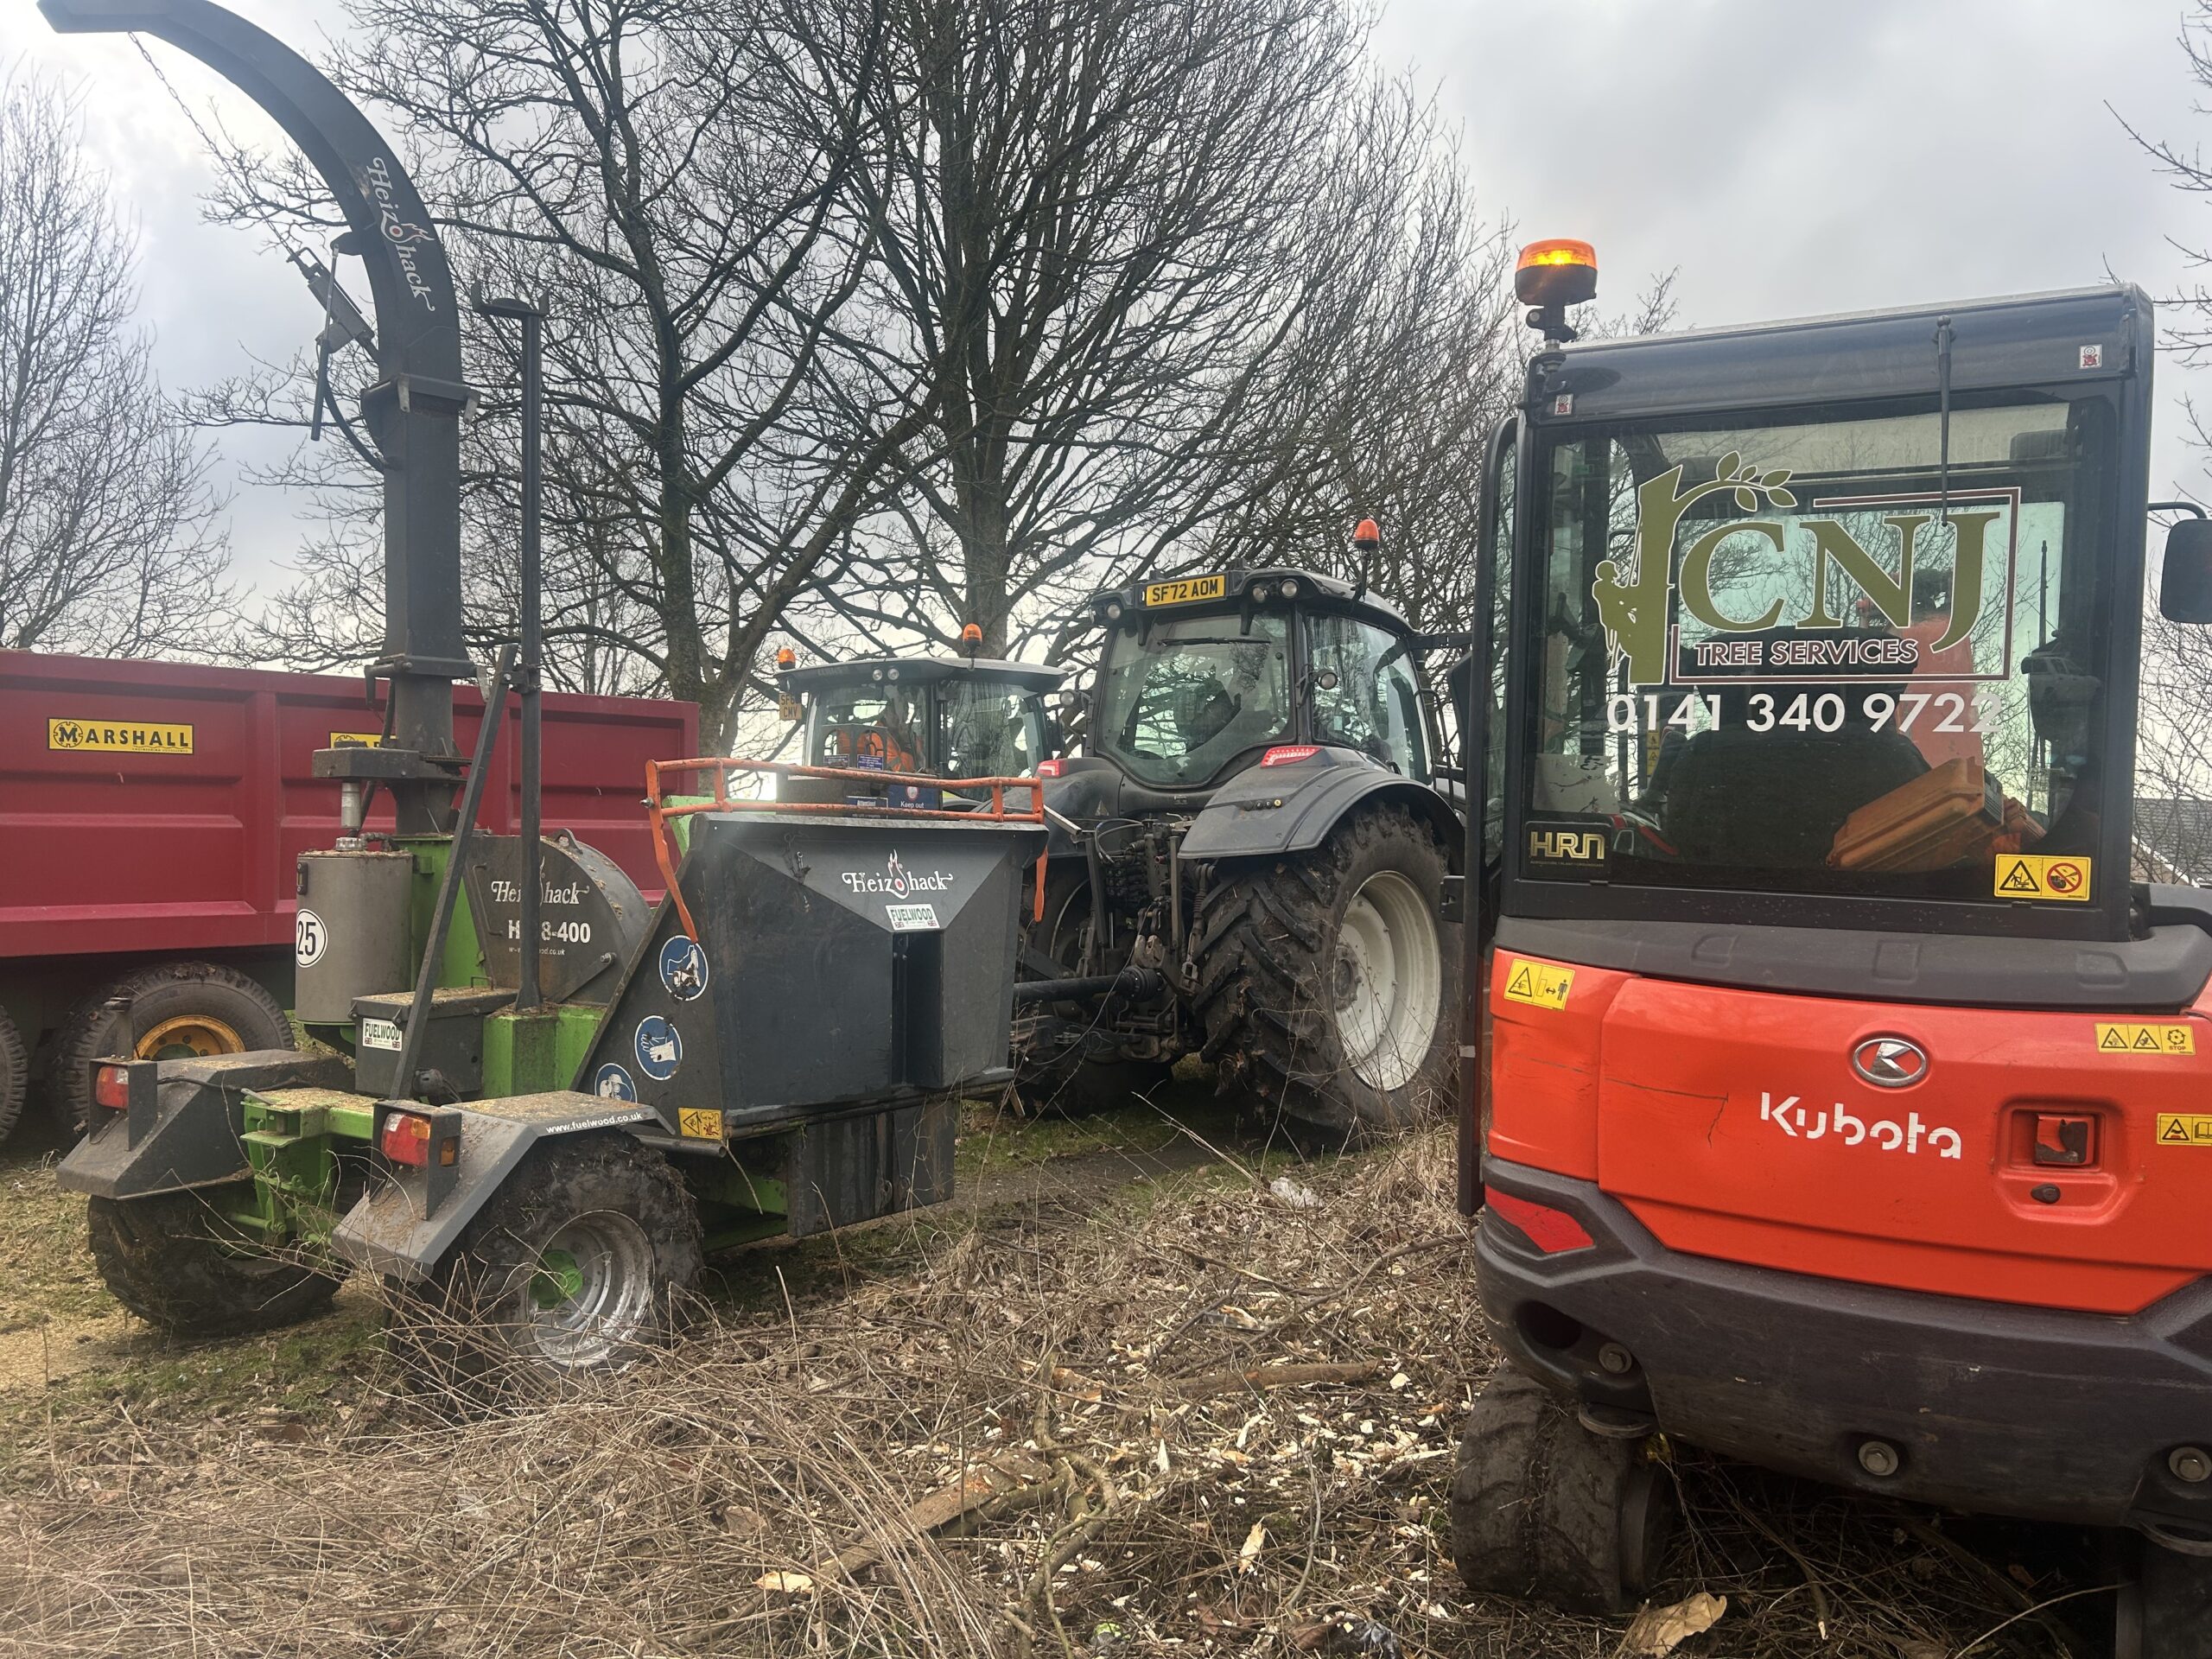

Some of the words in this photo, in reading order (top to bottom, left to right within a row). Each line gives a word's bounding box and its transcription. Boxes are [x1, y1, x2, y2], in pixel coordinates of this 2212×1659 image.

[1153, 584, 1187, 602] SF72
[1192, 579, 1218, 598] AOM
[1681, 512, 2000, 654] CNJ
[1694, 641, 1763, 665] TREE
[1770, 639, 1919, 664] SERVICES
[1606, 694, 1722, 732] 0141
[1746, 694, 1845, 733] 340
[1862, 694, 2003, 734] 9722
[59, 727, 188, 747] MARSHALL
[890, 907, 933, 922] FUELWOOD
[297, 920, 316, 957] 25
[365, 1022, 400, 1041] FUELWOOD
[546, 1112, 643, 1133] www.fuelwood.co.uk
[1760, 1091, 1961, 1160] Kubota
